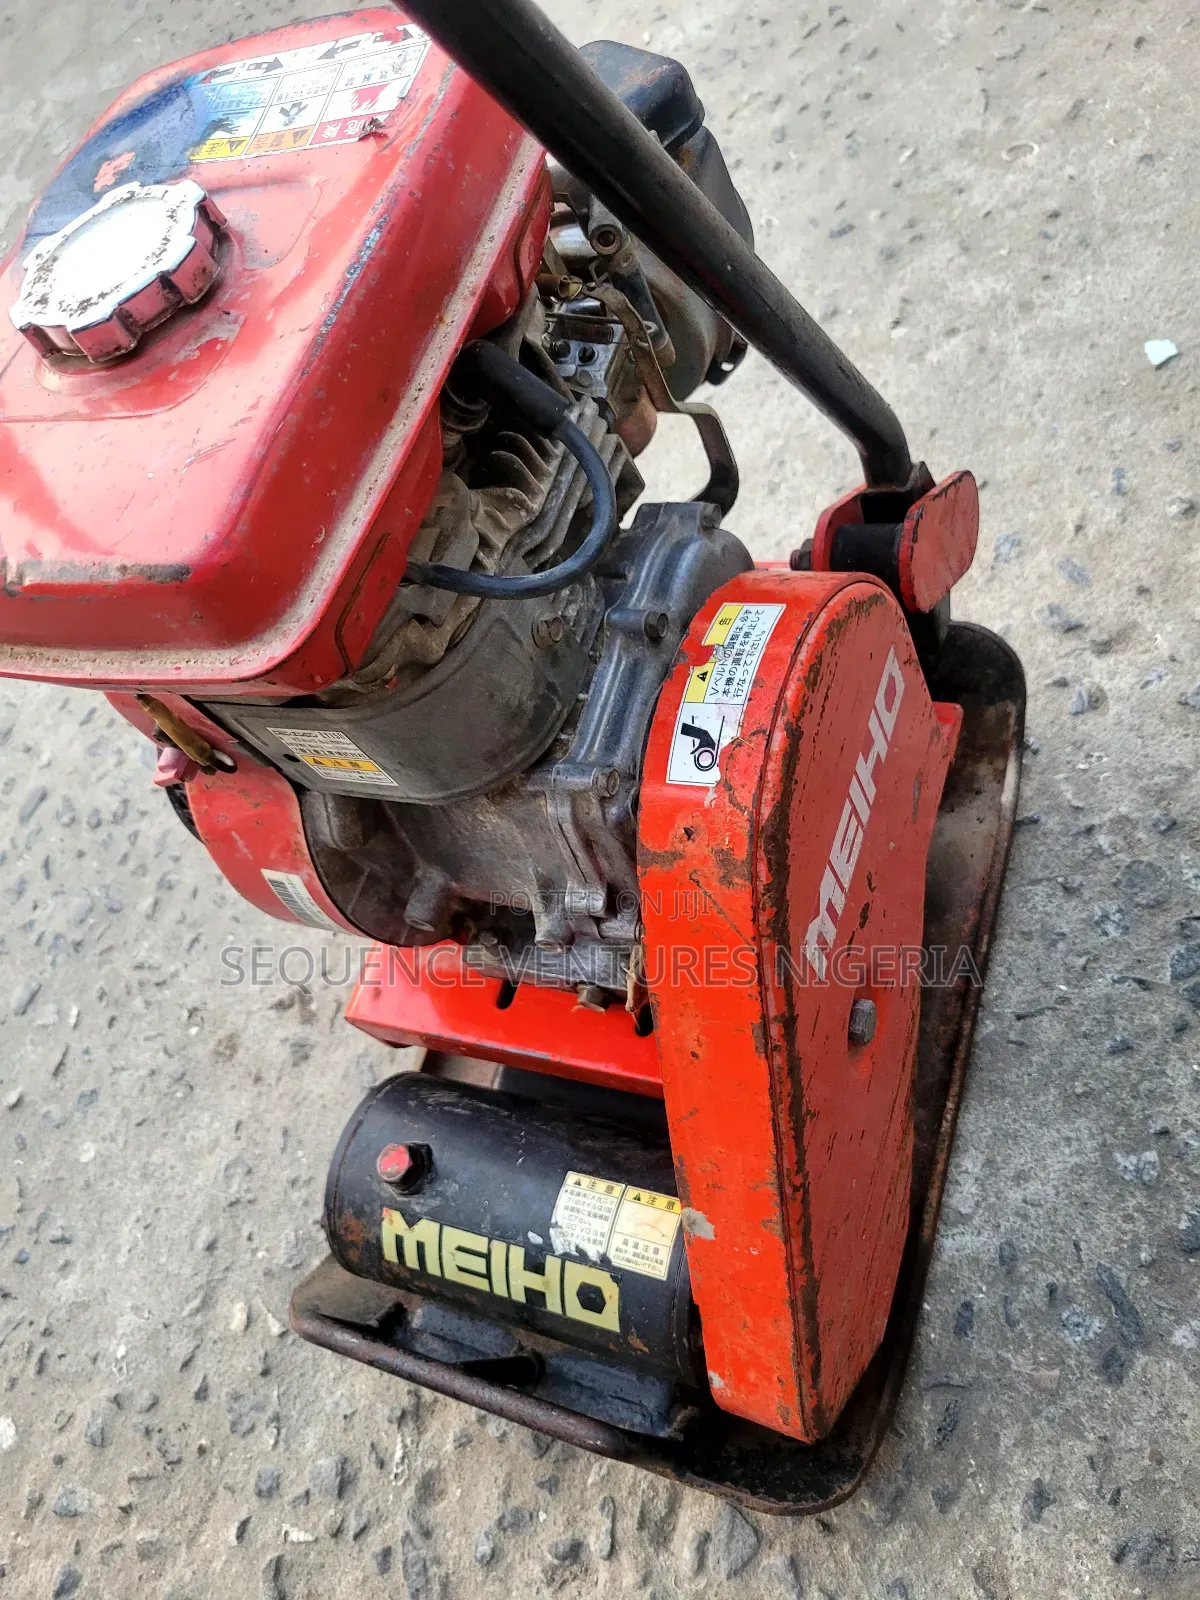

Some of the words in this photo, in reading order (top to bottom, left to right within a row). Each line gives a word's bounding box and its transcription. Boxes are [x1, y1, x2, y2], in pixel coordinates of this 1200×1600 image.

[804, 645, 905, 980] MEIHO
[586, 1179, 614, 1194] 注意
[646, 1194, 675, 1210] 注意
[380, 1207, 620, 1332] MEIHO
